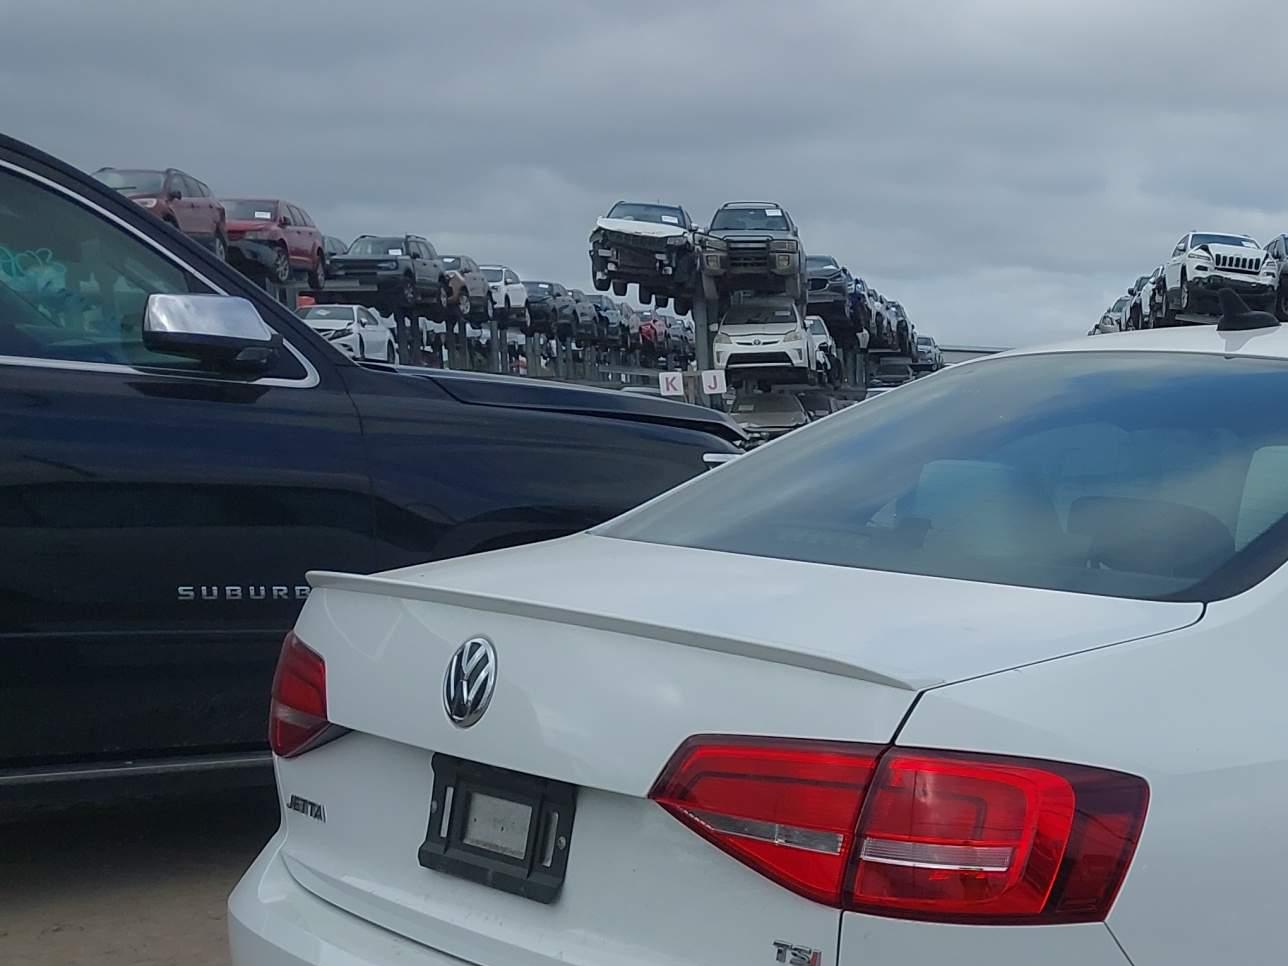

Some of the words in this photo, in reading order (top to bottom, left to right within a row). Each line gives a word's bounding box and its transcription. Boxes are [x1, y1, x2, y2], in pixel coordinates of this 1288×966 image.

[665, 376, 678, 392] K
[707, 375, 719, 390] J
[177, 585, 312, 600] SUBURB
[286, 794, 327, 823] JETTA
